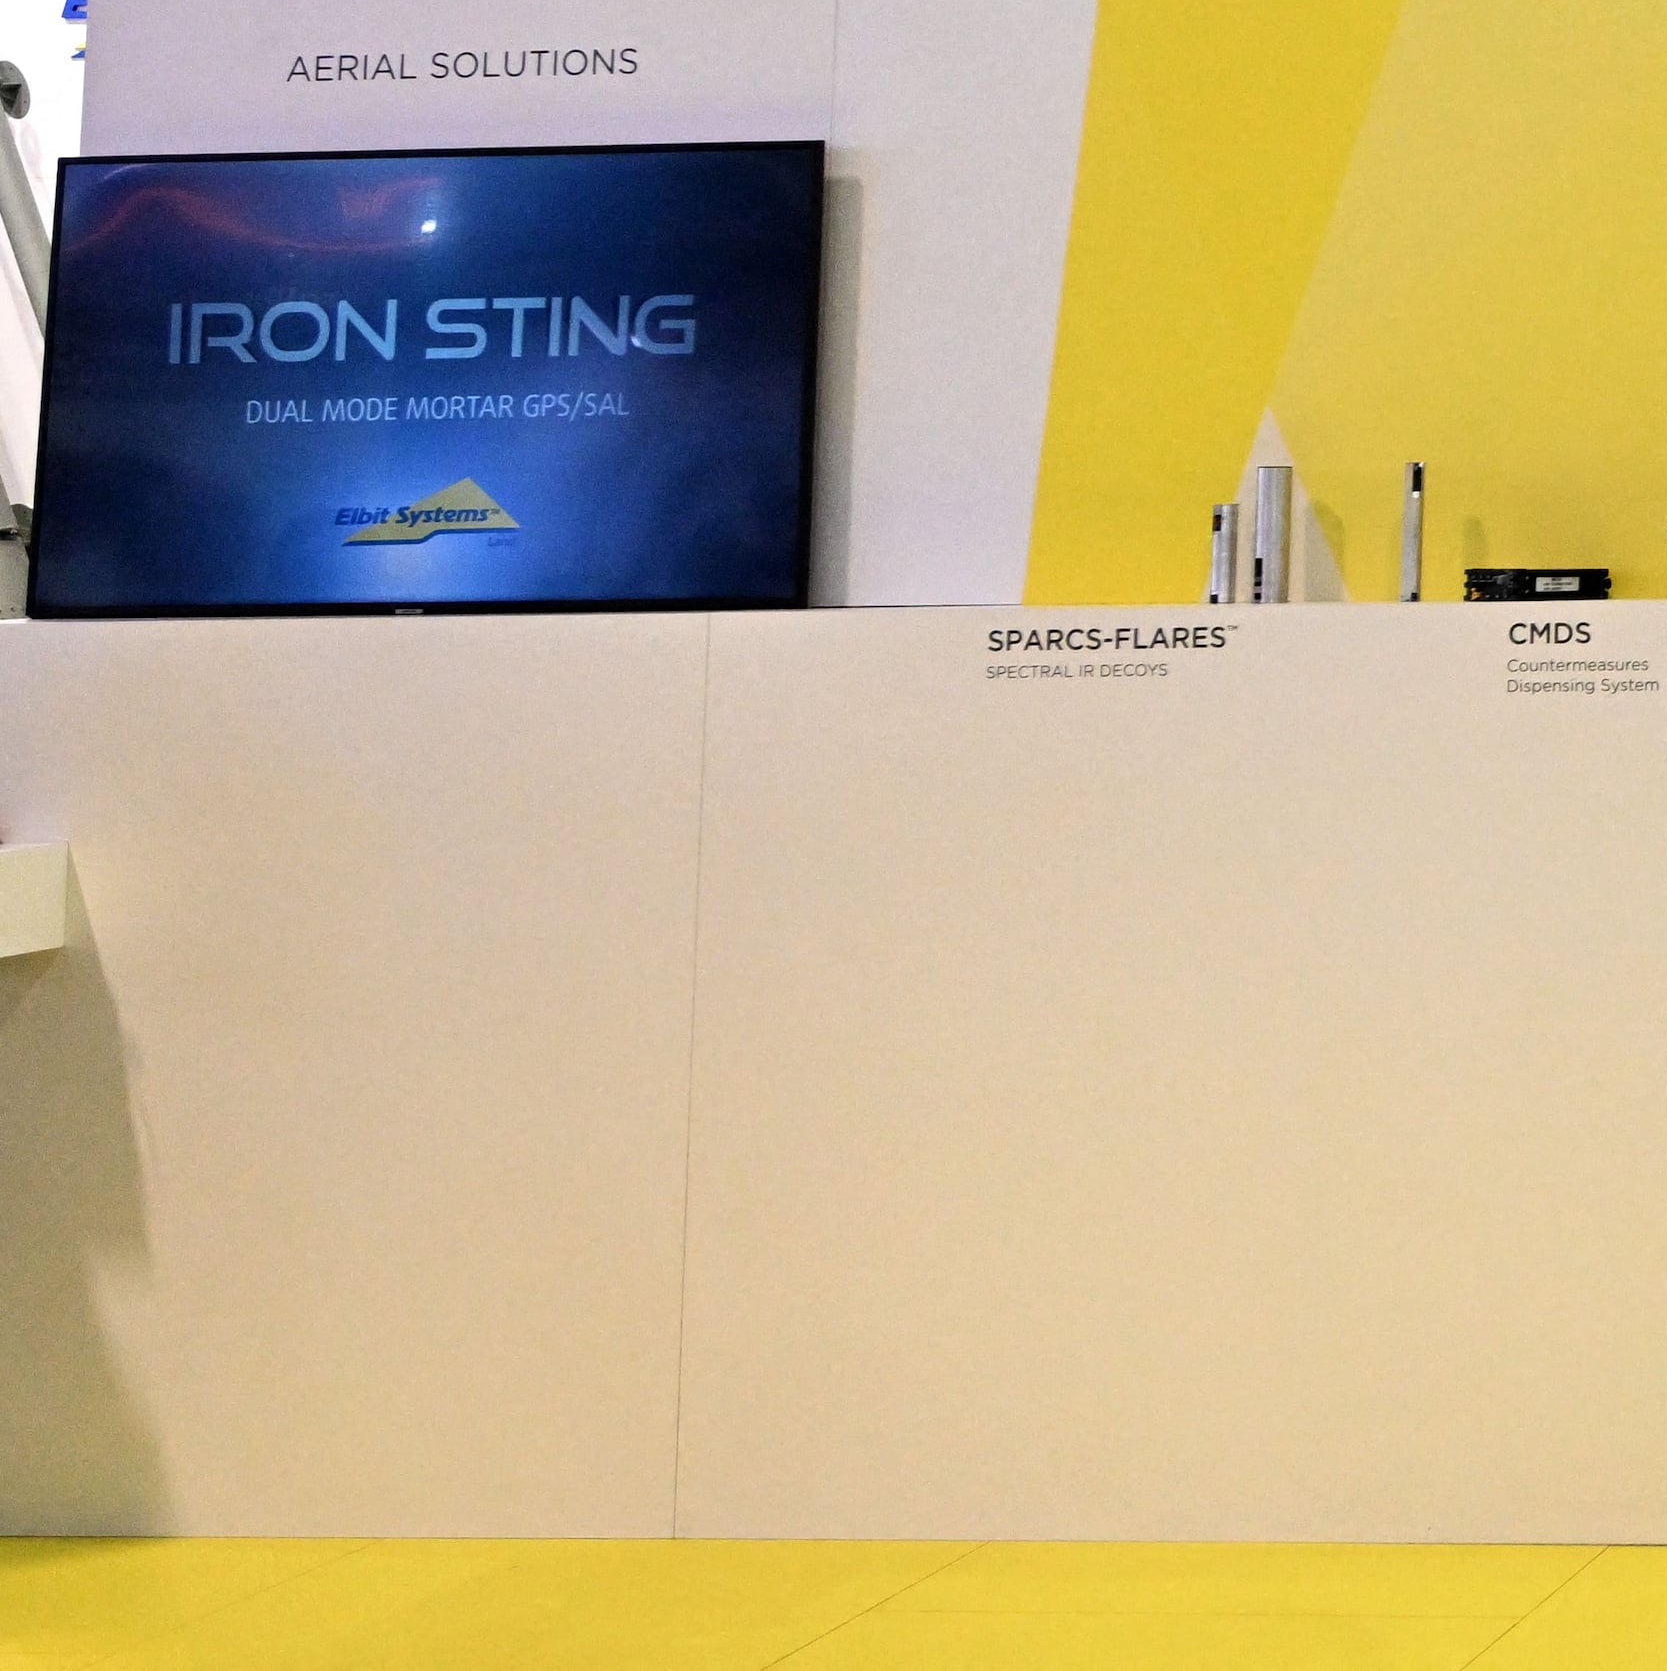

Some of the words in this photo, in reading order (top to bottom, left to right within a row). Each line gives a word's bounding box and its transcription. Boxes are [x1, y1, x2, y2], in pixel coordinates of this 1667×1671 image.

[286, 53, 417, 82] AERIAL
[430, 48, 639, 79] SOLUTIONS
[168, 299, 398, 364] IRON
[425, 294, 697, 360] STING
[246, 400, 313, 424] DUAL
[322, 397, 398, 422] MODE
[406, 394, 514, 420] MORTAR
[523, 390, 629, 421] GPS/SAL
[335, 507, 391, 526] Elbit
[1509, 621, 1591, 645] CMDS
[986, 664, 1073, 679] SPECTRAL
[1079, 664, 1094, 677] IR
[1100, 663, 1168, 678] DECOYS
[1507, 657, 1649, 673] Countermeasures
[1507, 679, 1595, 695] Dispensing
[1601, 678, 1660, 695] System
